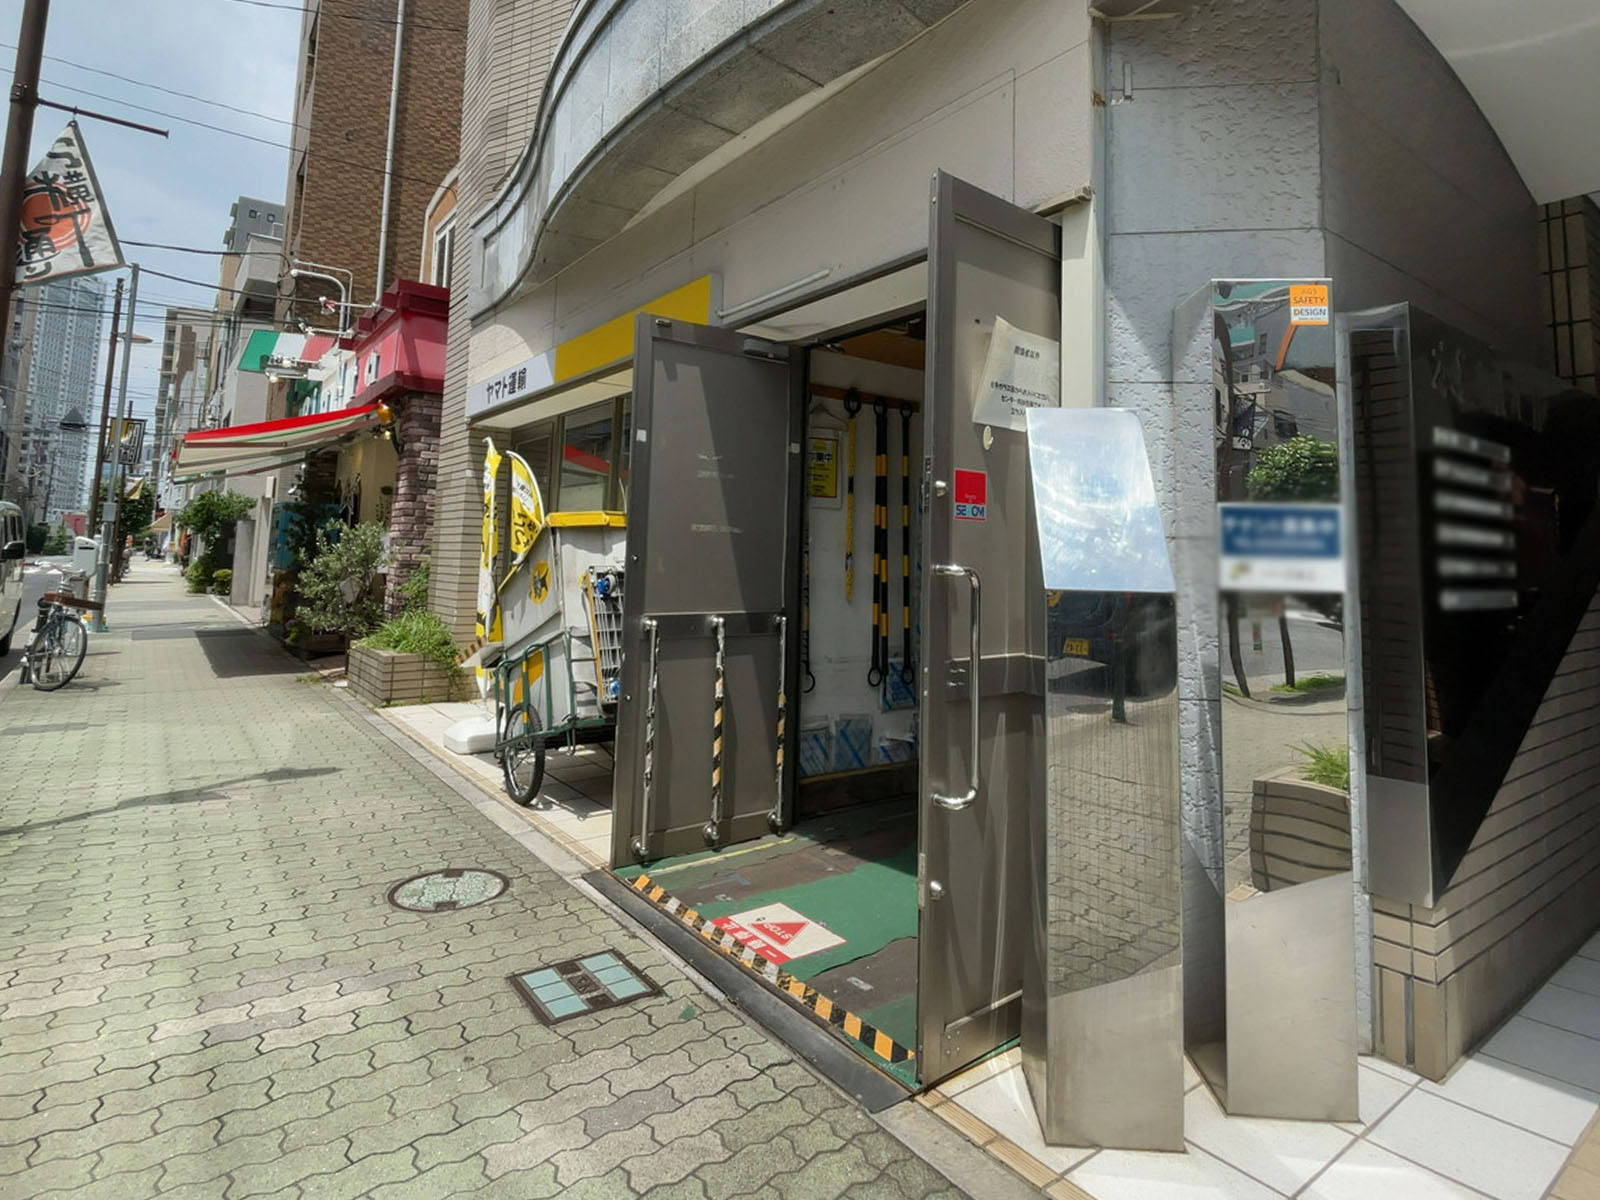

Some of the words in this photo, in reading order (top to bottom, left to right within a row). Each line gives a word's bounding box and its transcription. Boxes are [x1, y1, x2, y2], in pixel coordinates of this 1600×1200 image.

[1293, 296, 1325, 305] SAFETY
[1293, 308, 1327, 316] DESIGN
[486, 367, 528, 405] ヤマト運輸
[762, 921, 793, 940] STOP
